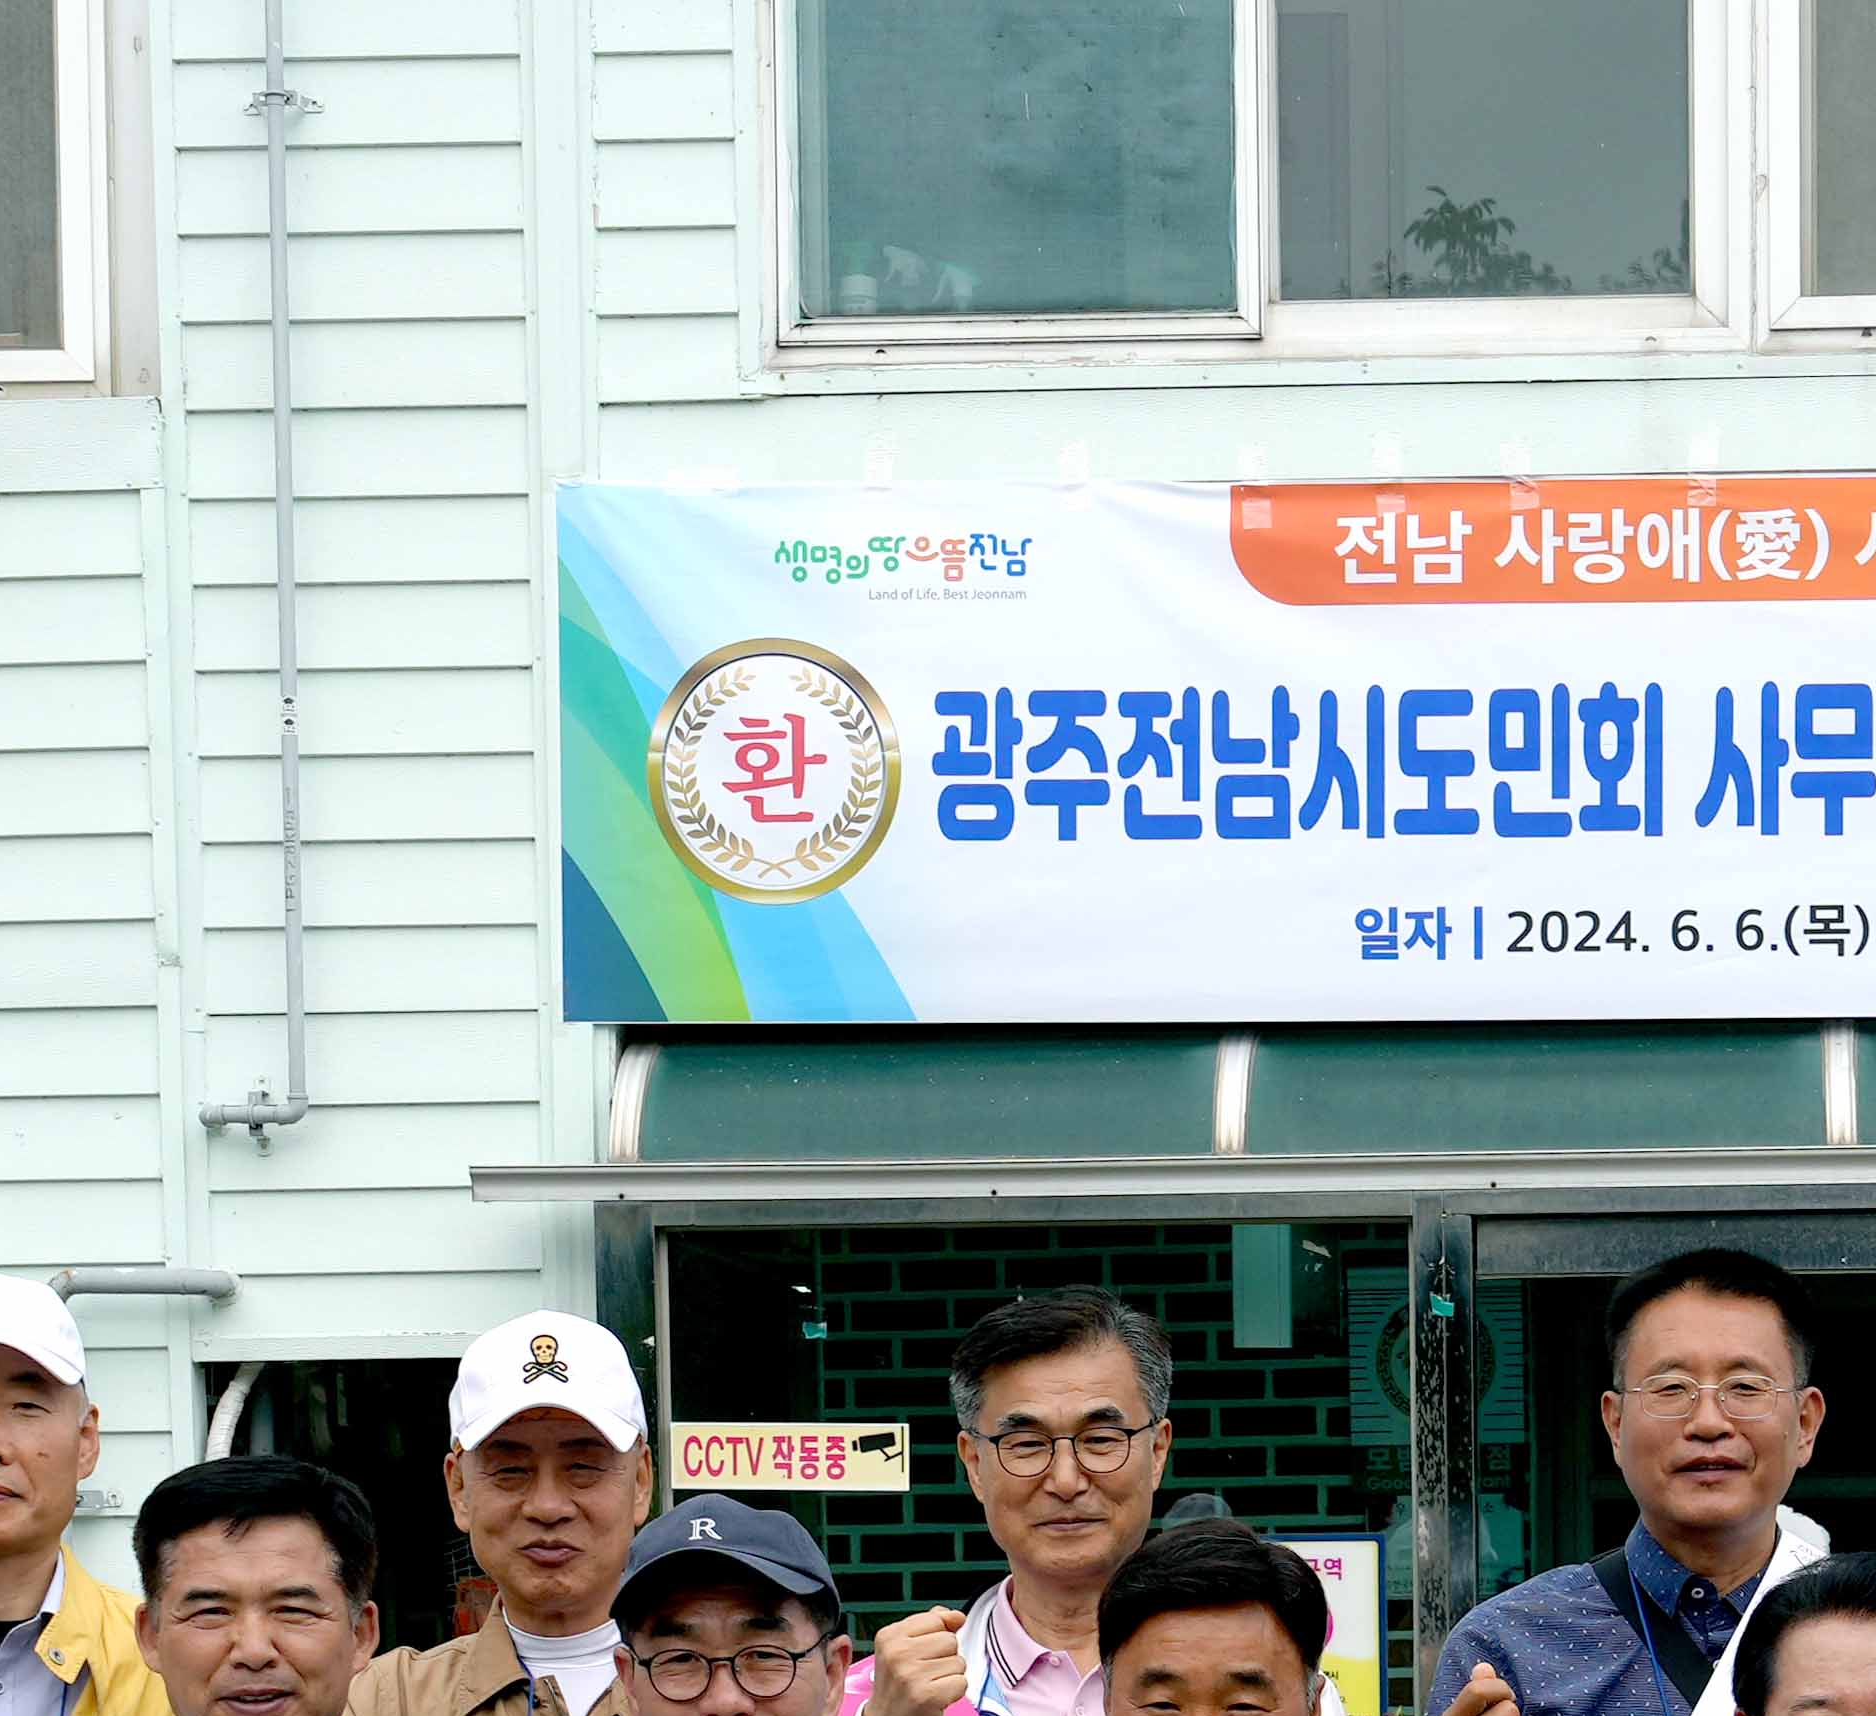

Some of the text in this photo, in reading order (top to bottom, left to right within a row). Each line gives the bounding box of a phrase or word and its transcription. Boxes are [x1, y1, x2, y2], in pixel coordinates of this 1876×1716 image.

[1334, 517, 1466, 586] 전남
[1493, 507, 1833, 586] 사랑애(愛)
[869, 588, 1027, 601] Land of Life, Best Jeonnam
[721, 714, 827, 823] 환
[930, 680, 1664, 843] 광주전남시도민회
[1354, 905, 1453, 960] 일자
[1506, 908, 1650, 955] 2024.
[1670, 908, 1713, 955] 6.
[1734, 905, 1871, 960] 6.(목)
[682, 1435, 847, 1481] CCTV 작동중
